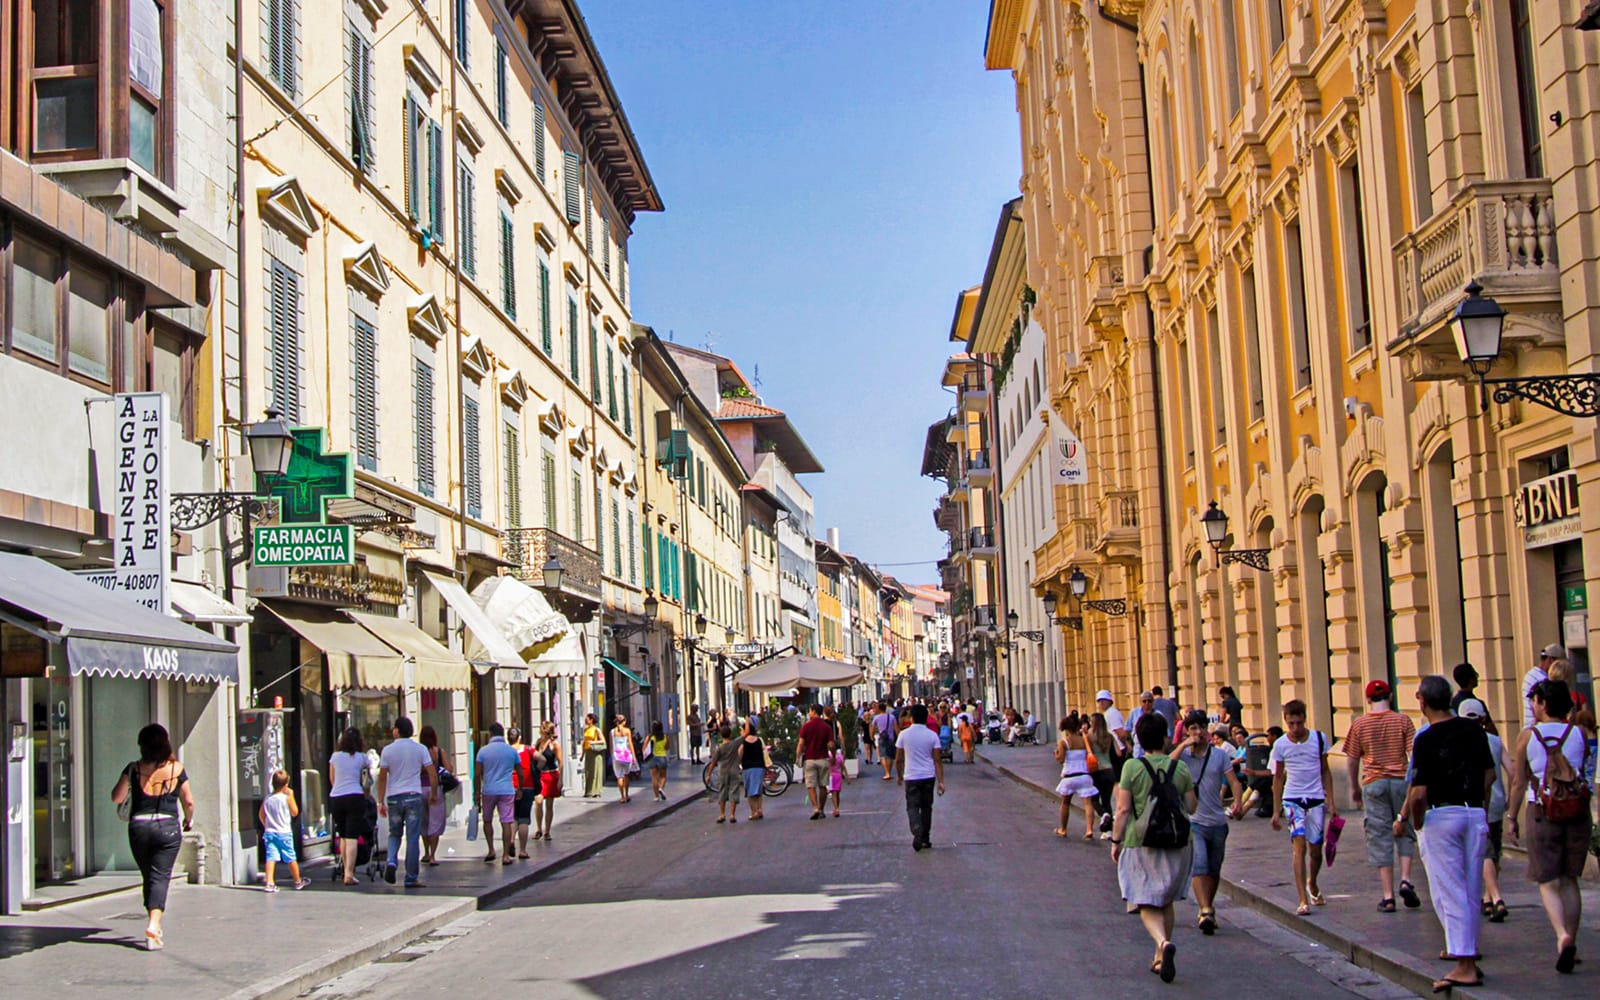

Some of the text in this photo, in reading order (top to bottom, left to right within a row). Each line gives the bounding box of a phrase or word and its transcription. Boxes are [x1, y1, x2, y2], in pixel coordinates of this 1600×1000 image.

[142, 410, 158, 422] LA
[119, 396, 136, 567] AGENZIA
[1060, 469, 1080, 477] Coni
[142, 427, 158, 550] TORRE
[1528, 474, 1580, 525] BNL
[259, 529, 343, 545] FARMACIA
[257, 546, 345, 562] OMEOPATIA
[143, 647, 179, 671] KAOS
[58, 701, 67, 822] OUTLET
